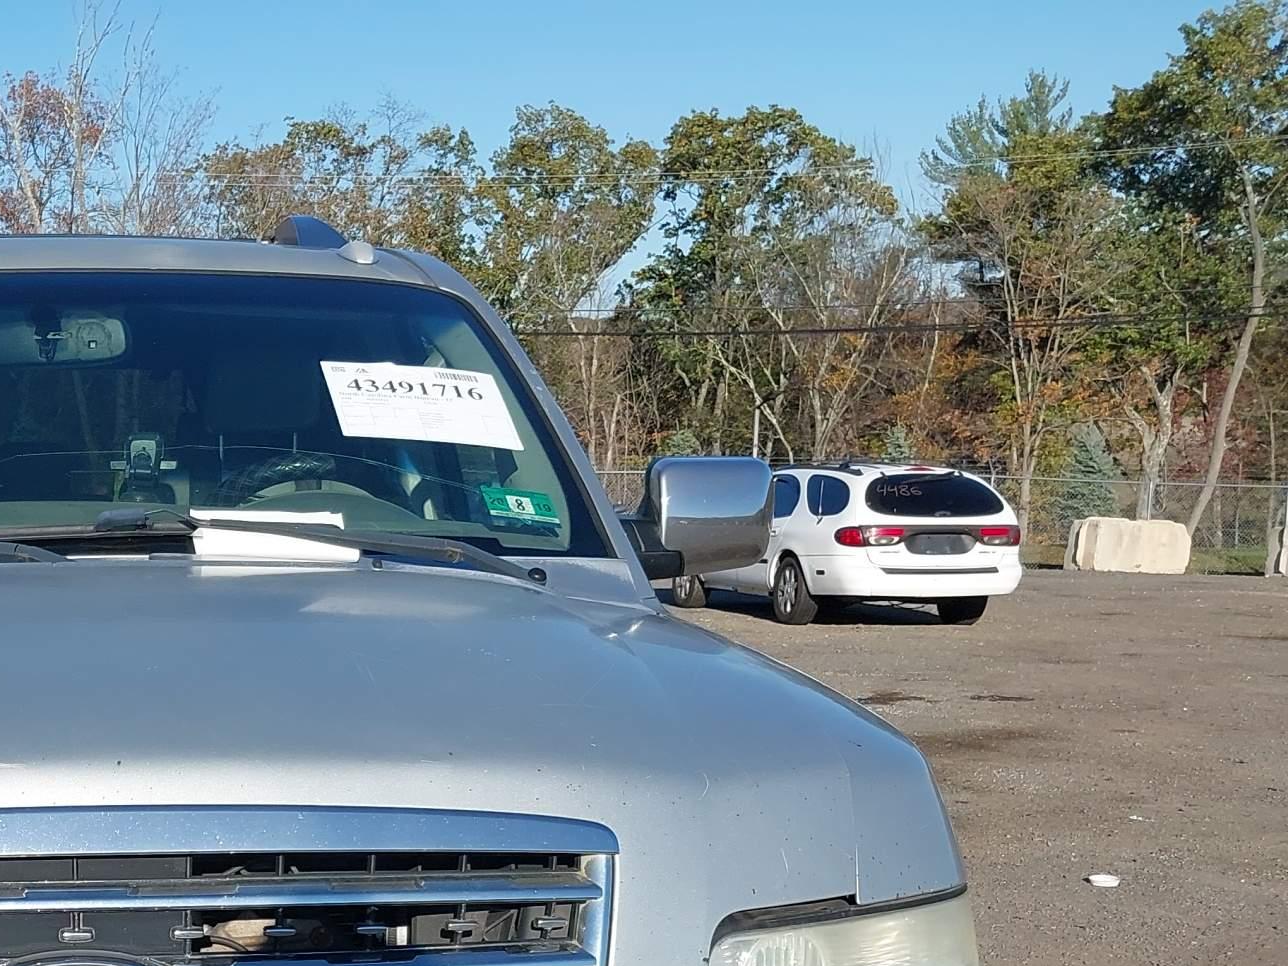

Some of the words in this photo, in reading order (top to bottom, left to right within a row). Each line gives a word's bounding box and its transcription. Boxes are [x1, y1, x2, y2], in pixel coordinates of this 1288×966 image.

[346, 378, 484, 401] 43491716
[876, 483, 922, 497] 4486
[515, 498, 526, 512] 8
